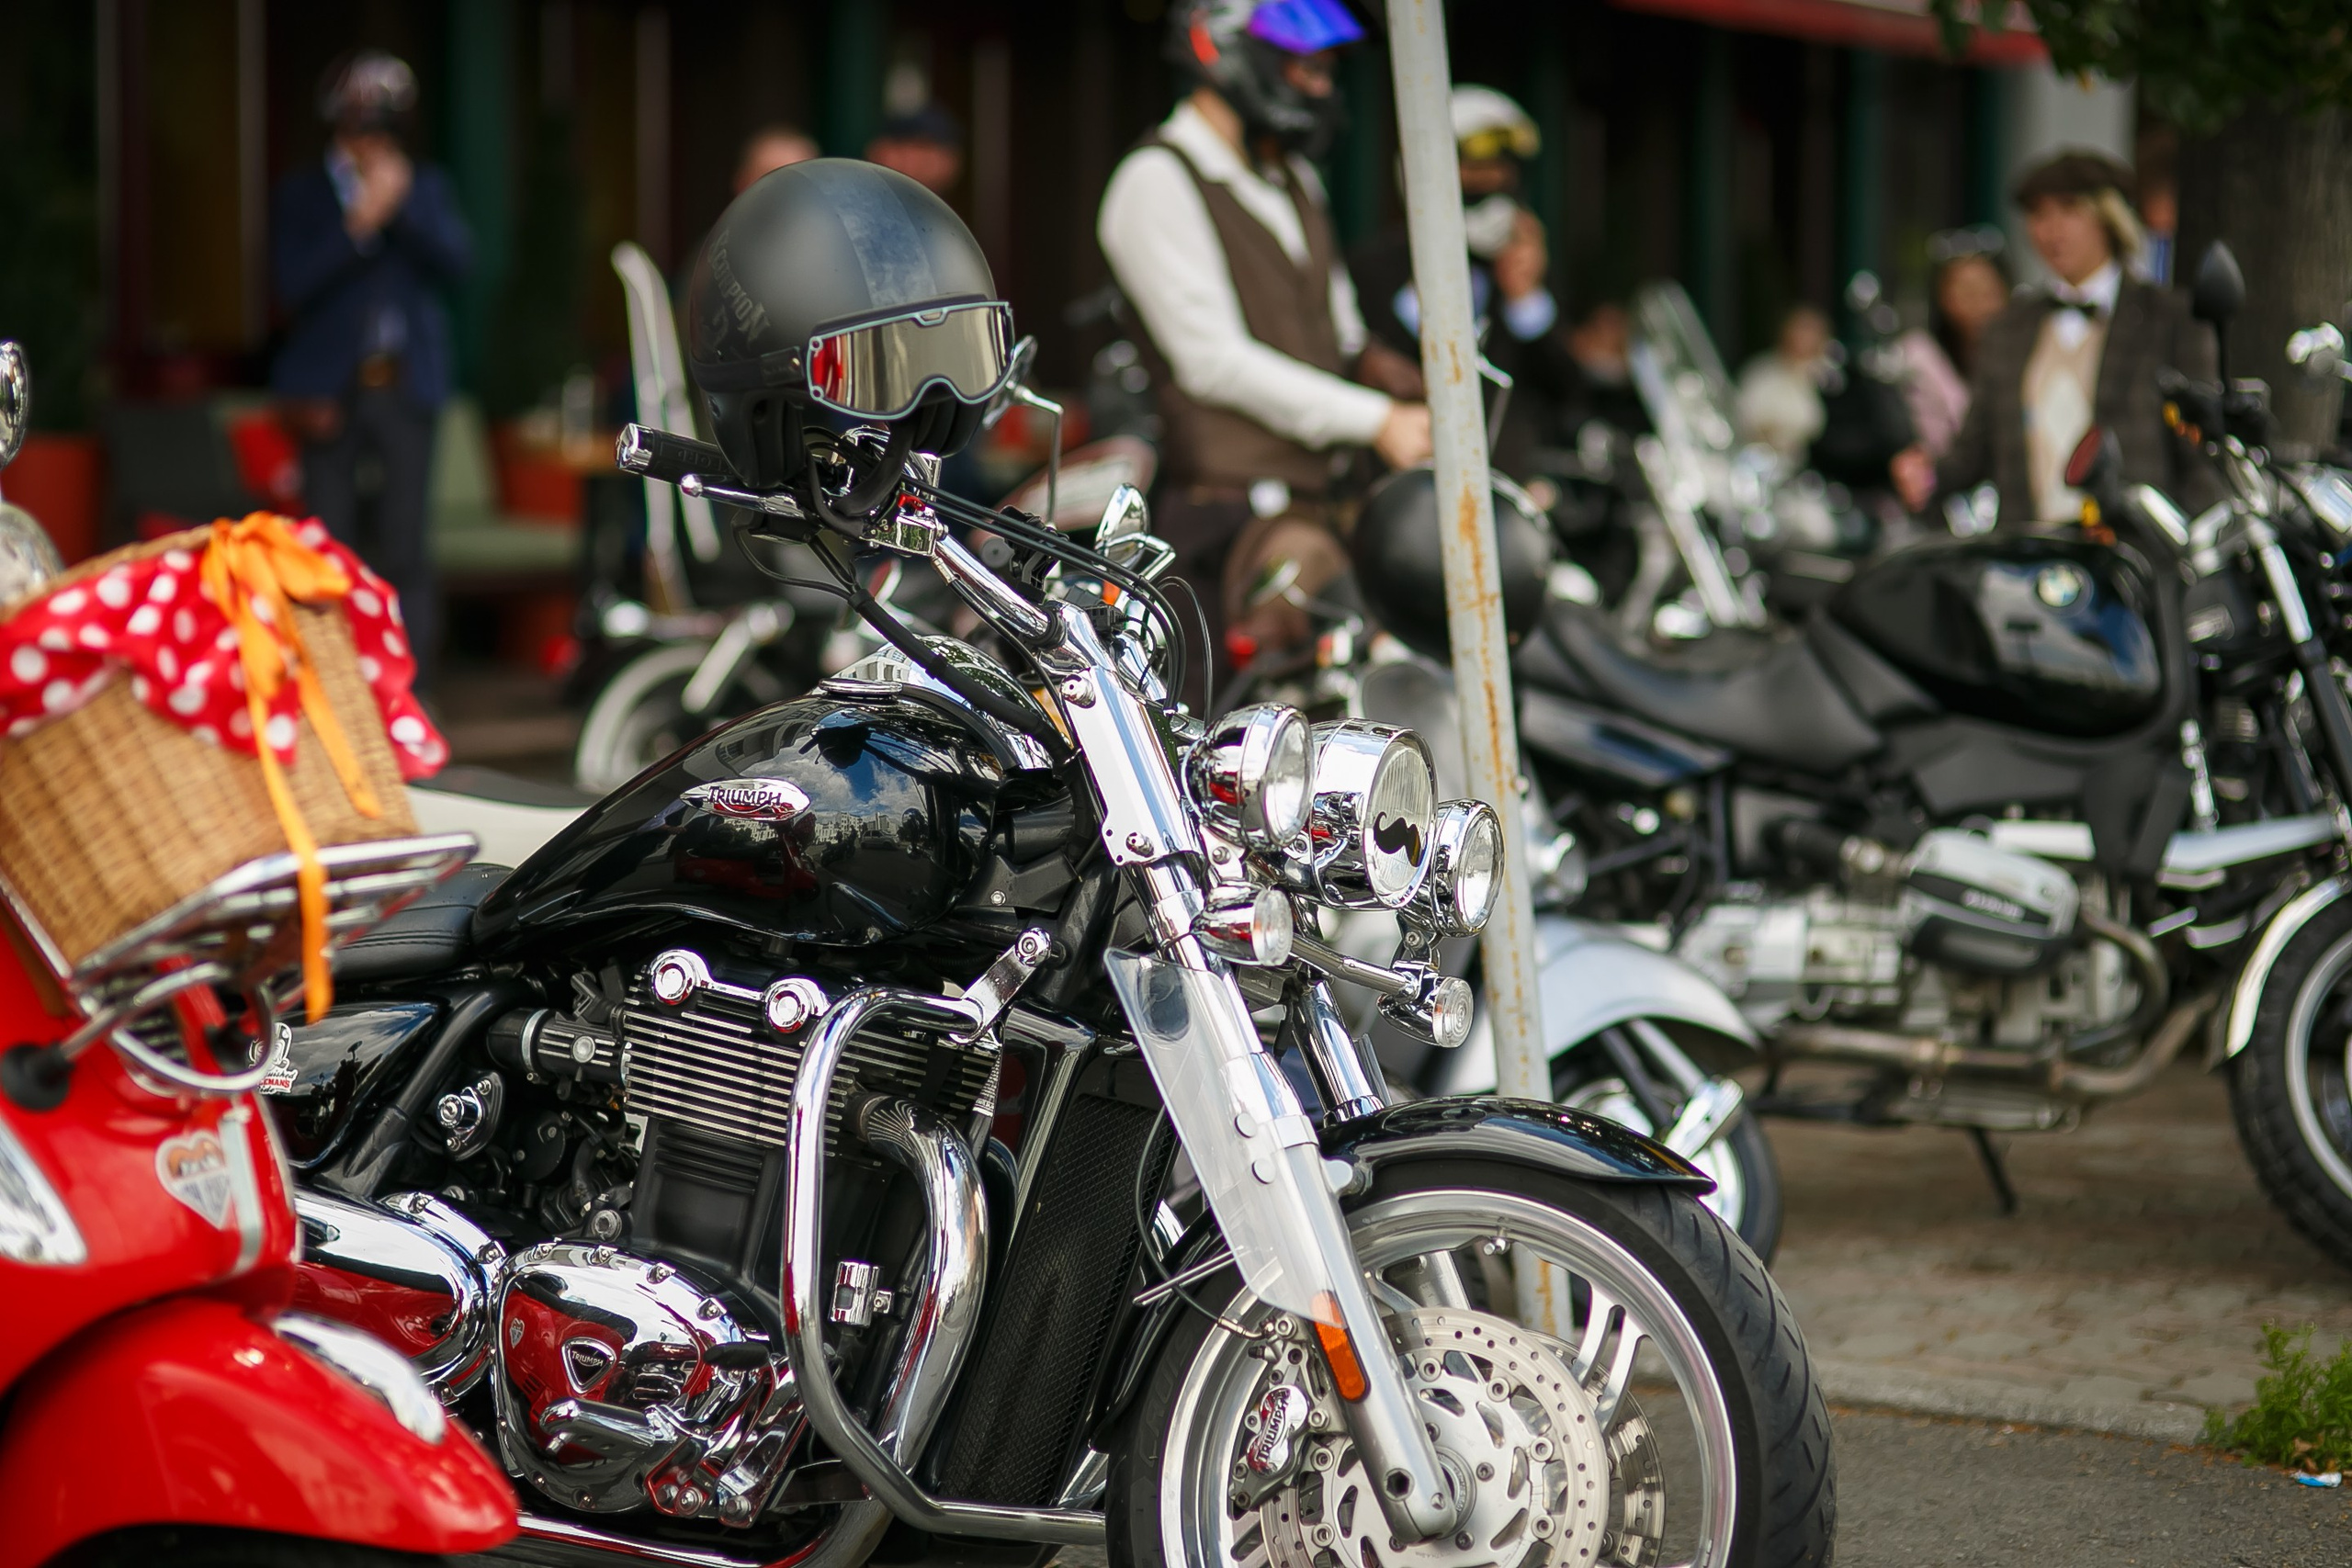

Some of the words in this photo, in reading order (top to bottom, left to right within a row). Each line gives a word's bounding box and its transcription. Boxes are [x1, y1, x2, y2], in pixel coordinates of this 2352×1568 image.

[707, 785, 783, 807] TRIUMPH
[571, 1350, 604, 1367] TRIUMPH
[1256, 1397, 1290, 1462] TRIUMPH
